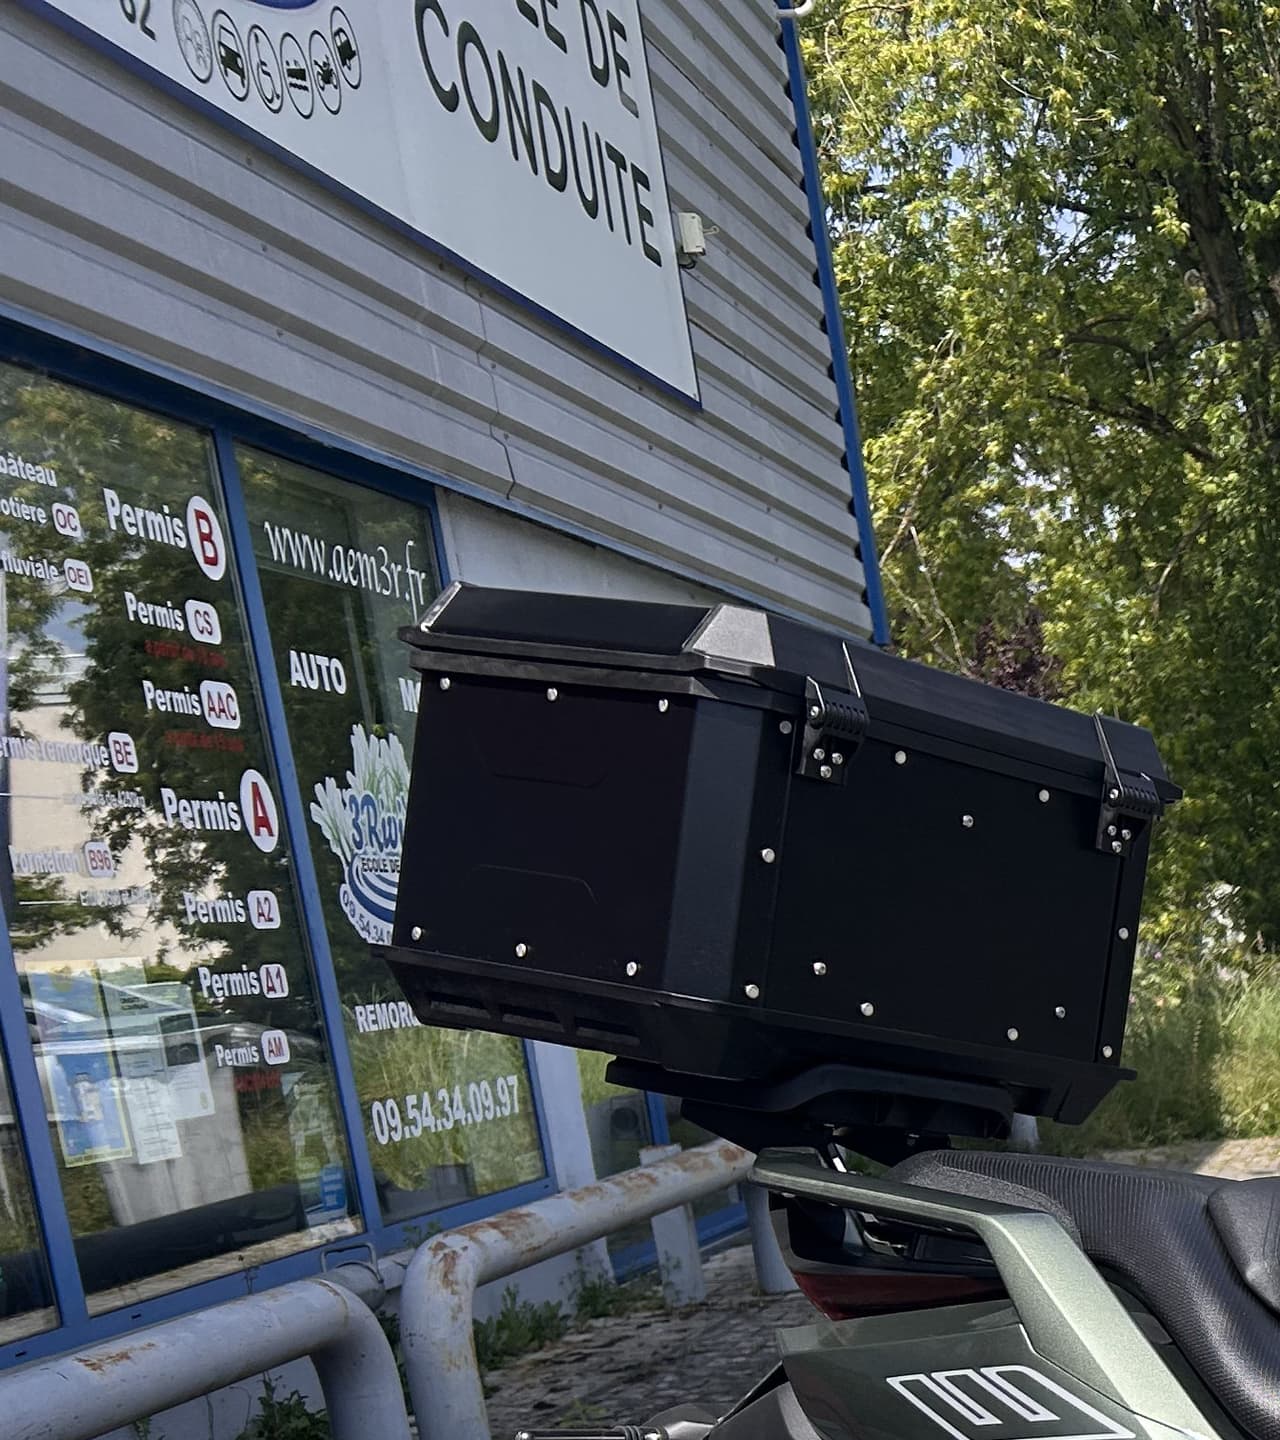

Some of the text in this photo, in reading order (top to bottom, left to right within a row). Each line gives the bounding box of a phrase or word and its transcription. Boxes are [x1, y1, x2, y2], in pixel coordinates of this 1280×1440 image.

[580, 0, 639, 118] DE
[415, 0, 662, 267] CONDUITE
[55, 508, 78, 532] OC
[103, 487, 219, 567] Permis B
[124, 590, 214, 636] Permis CS
[290, 650, 347, 695] AUTO
[142, 680, 237, 721] Permis AAC
[112, 740, 135, 767] BE
[162, 787, 242, 833] Permis
[250, 780, 275, 839] A
[88, 850, 112, 871] B96
[361, 858, 401, 874] ECOLE DE
[185, 891, 246, 925] Permis
[254, 896, 273, 923] A2
[198, 964, 285, 998] Permis A1
[215, 1037, 285, 1069] Permis AM
[370, 1075, 521, 1146] 09.54.34.09.97
